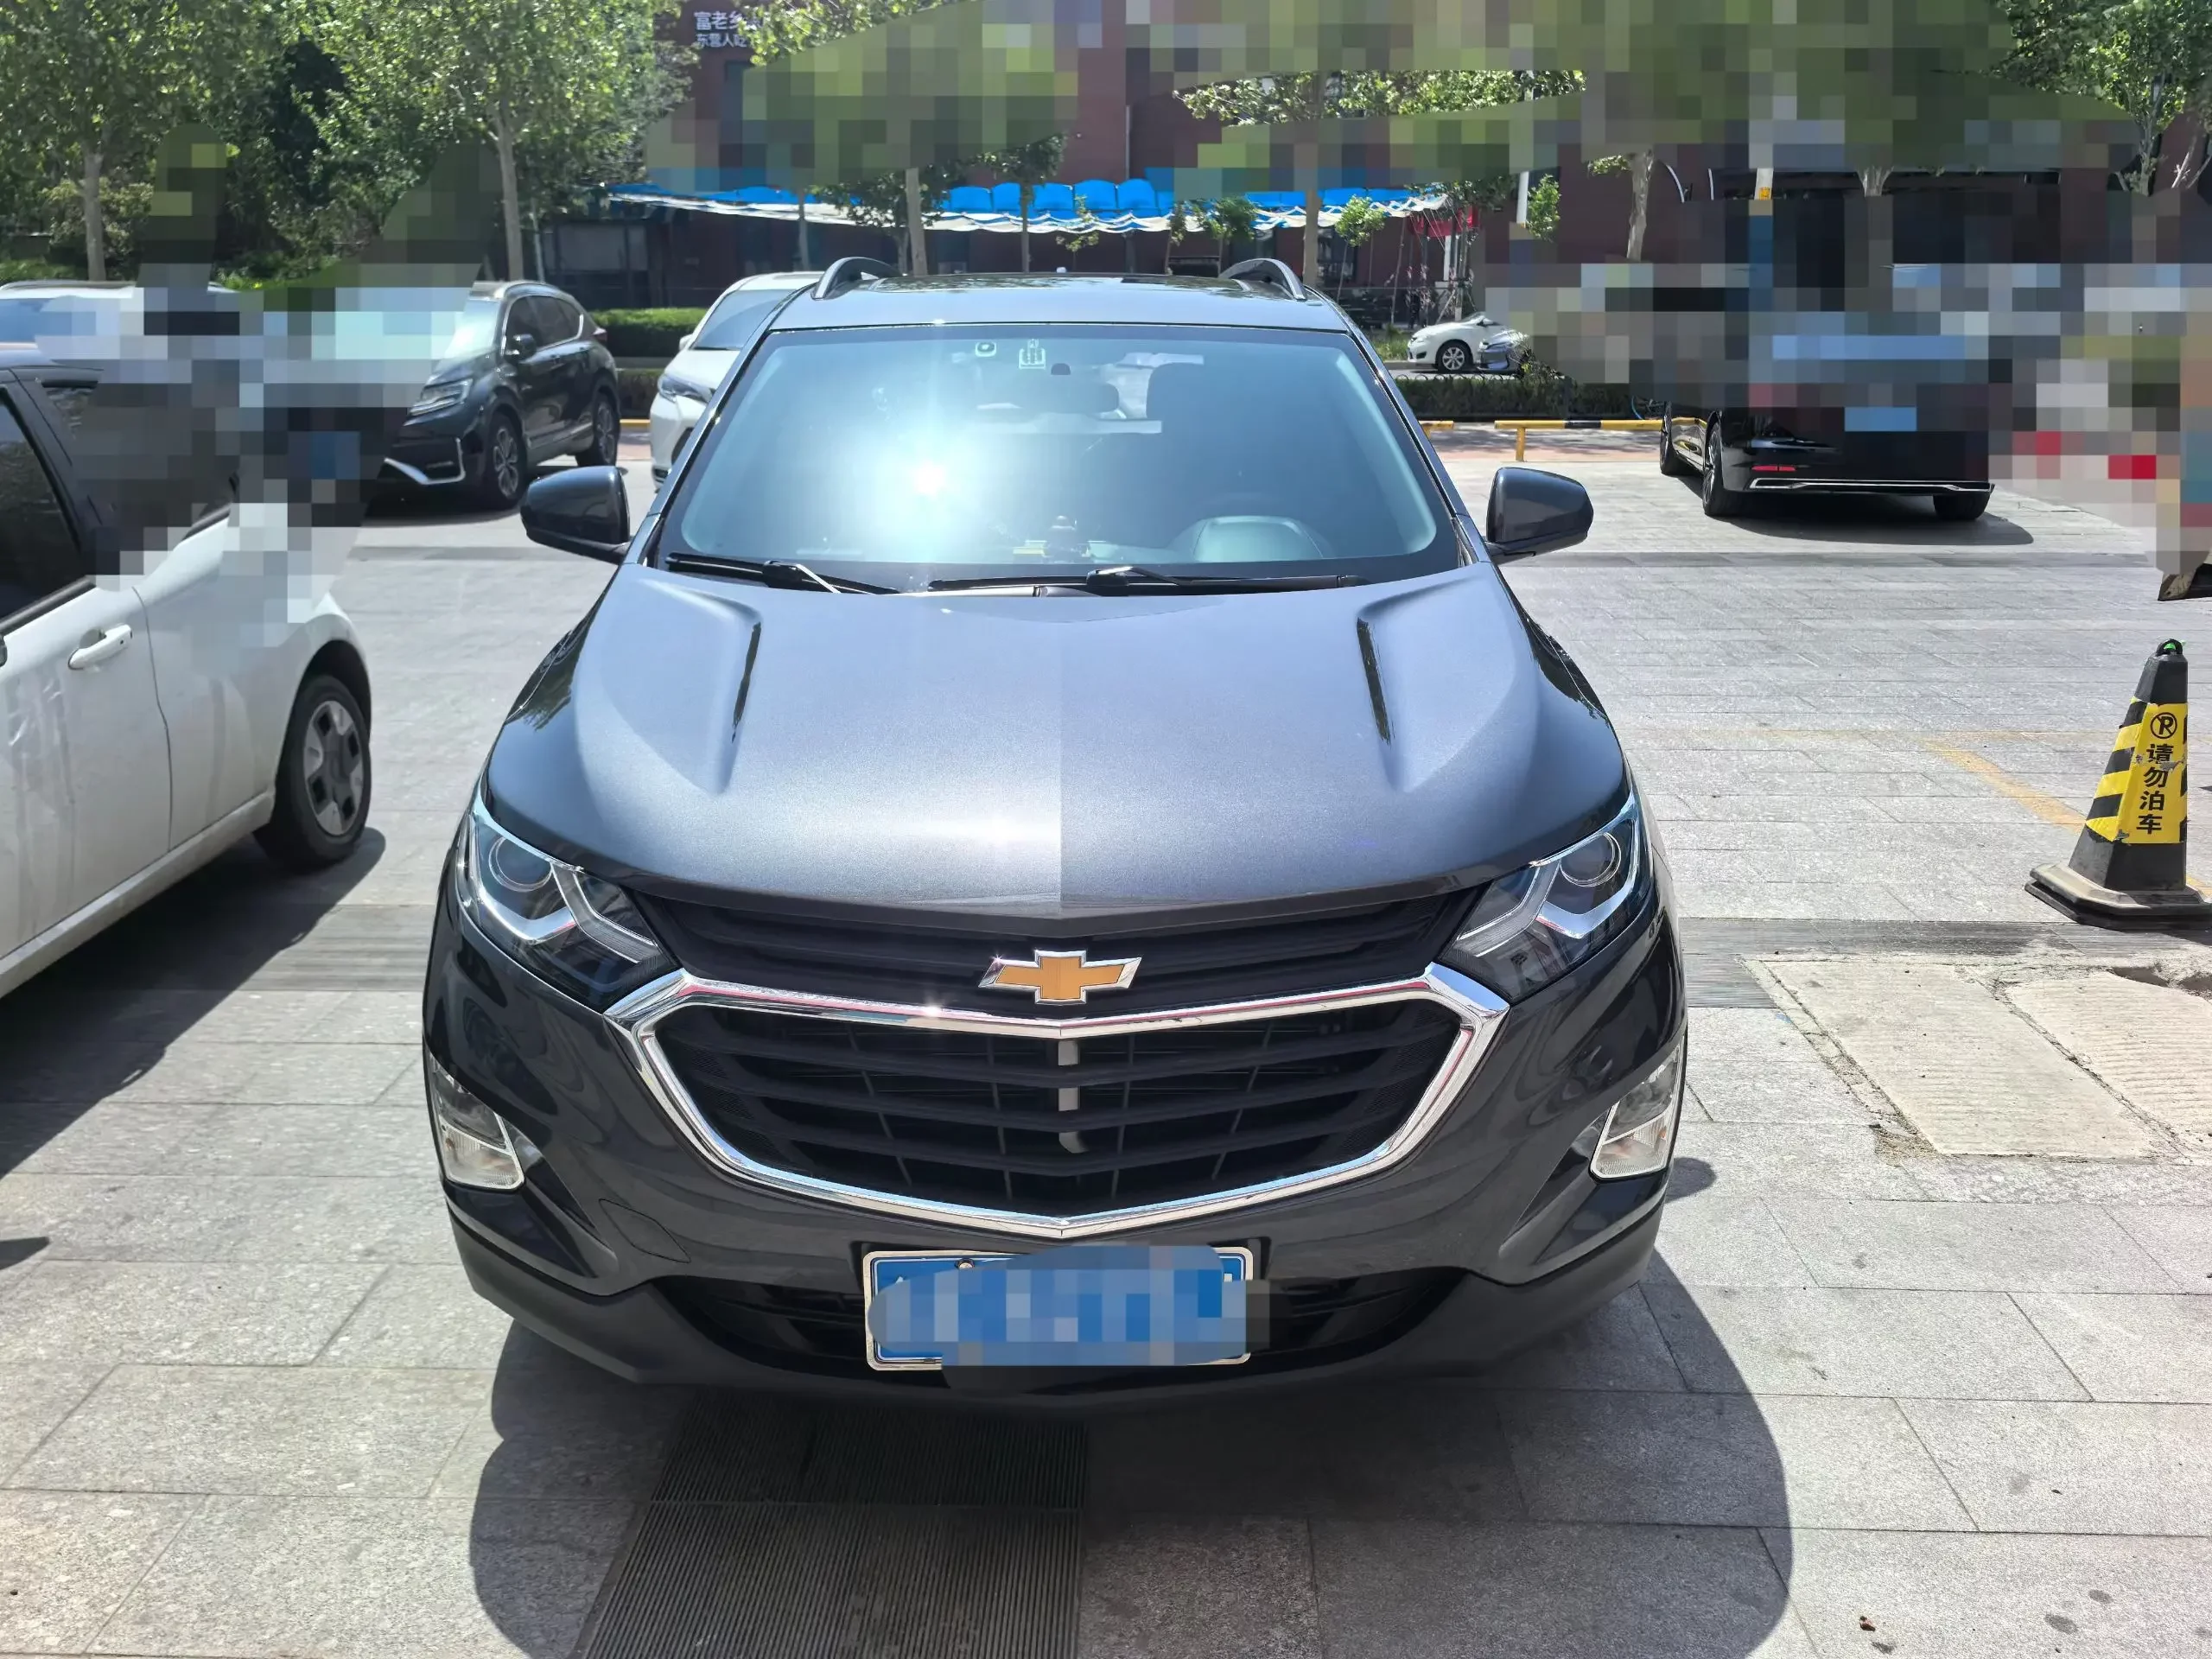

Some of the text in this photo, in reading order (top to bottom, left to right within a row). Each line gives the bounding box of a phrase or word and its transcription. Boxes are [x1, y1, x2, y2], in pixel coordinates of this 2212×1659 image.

[694, 10, 762, 31] 富老乡
[2136, 743, 2174, 835] 请勿泊车
